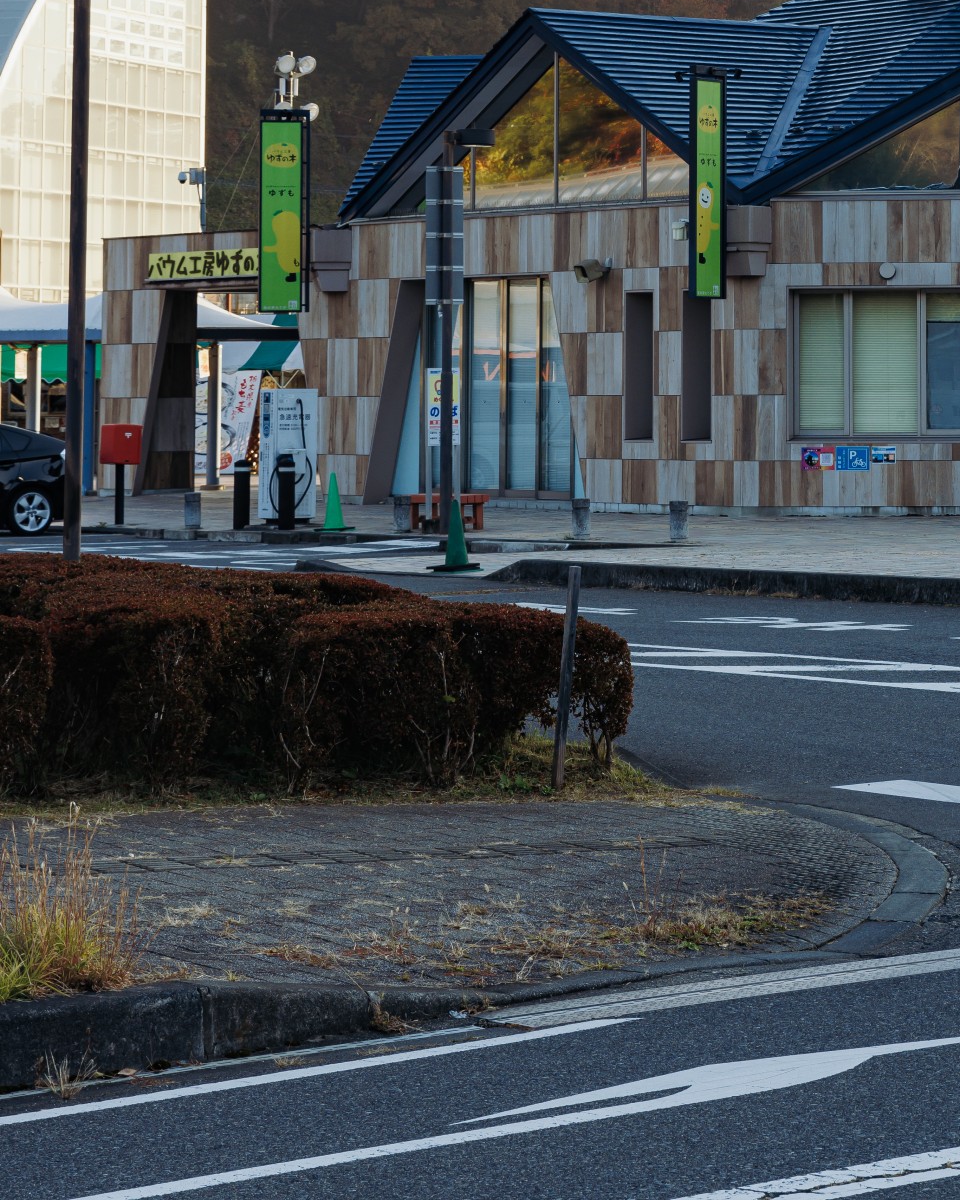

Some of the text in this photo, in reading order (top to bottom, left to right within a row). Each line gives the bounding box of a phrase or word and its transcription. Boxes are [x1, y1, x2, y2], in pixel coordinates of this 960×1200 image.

[266, 153, 297, 163] ゆずの木
[268, 189, 295, 197] ゆずも
[148, 249, 259, 278] バウム工房ゆずの
[849, 450, 857, 460] P
